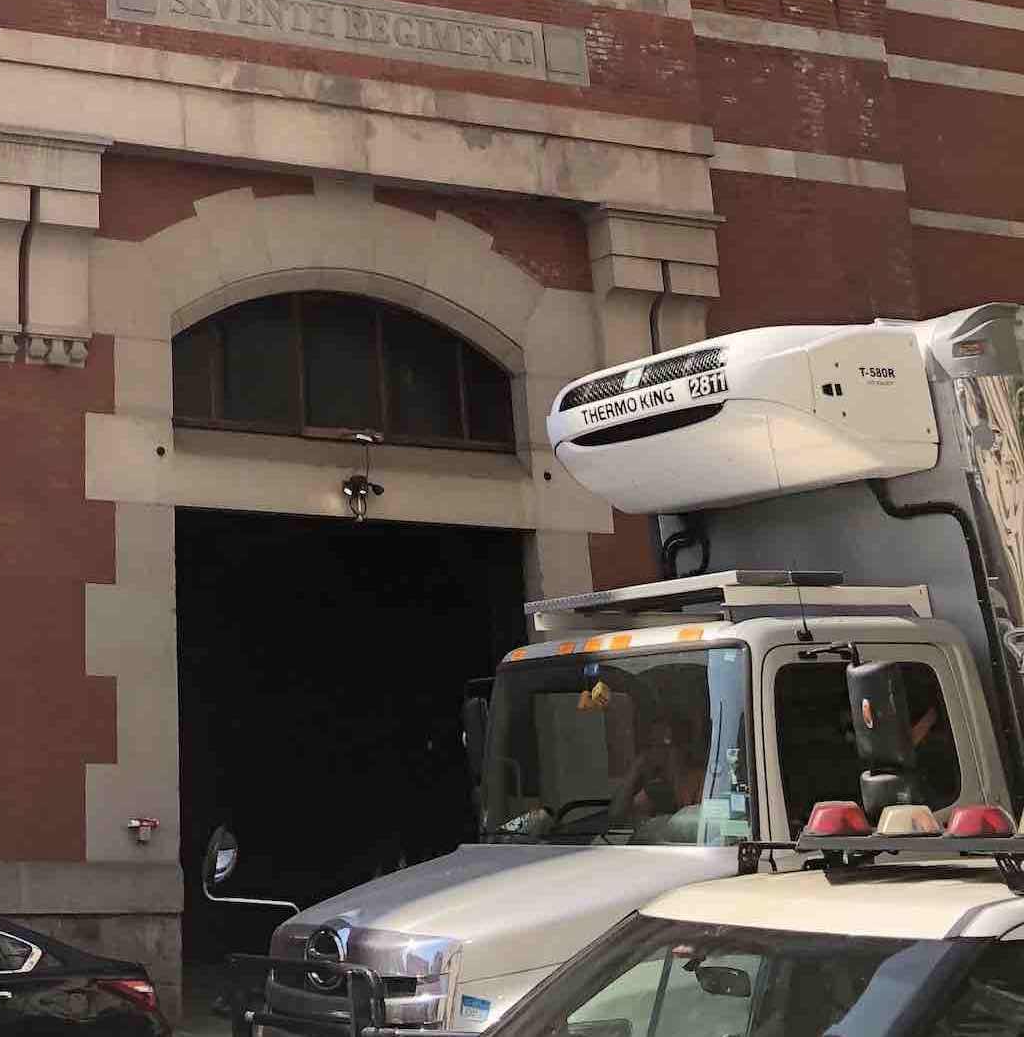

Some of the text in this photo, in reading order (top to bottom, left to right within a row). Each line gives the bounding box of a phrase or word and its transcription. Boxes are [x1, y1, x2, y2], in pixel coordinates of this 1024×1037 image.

[689, 371, 727, 399] 2811
[858, 367, 896, 379] T-580R
[581, 387, 676, 426] THERMO KING
